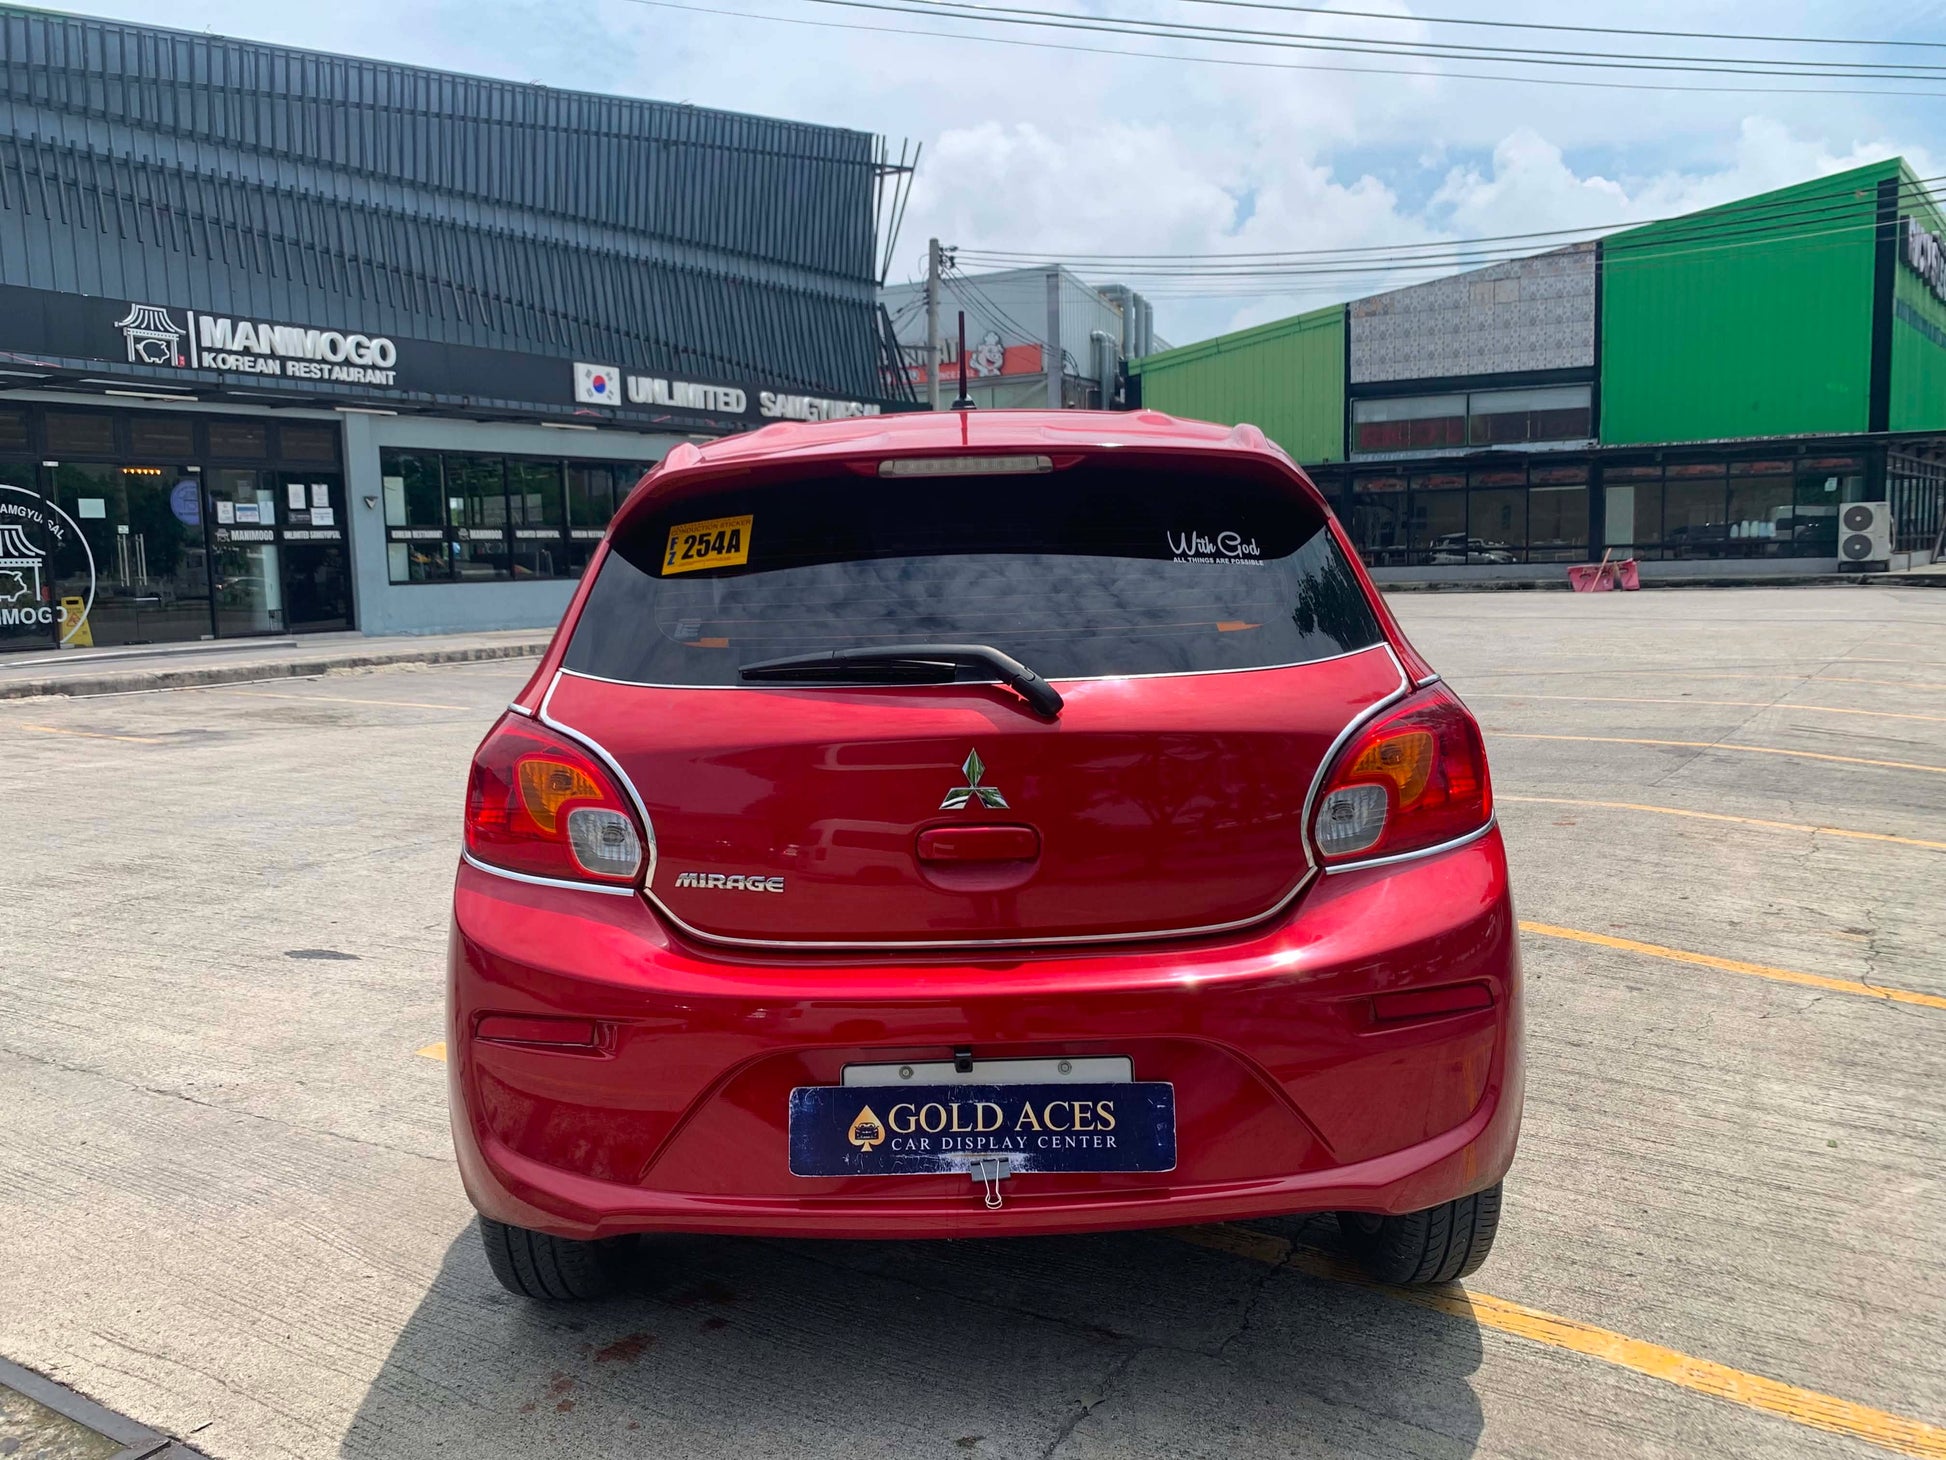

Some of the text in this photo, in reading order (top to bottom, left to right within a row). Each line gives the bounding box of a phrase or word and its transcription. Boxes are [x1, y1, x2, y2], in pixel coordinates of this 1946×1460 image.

[199, 315, 397, 368] MANIMOGO
[202, 352, 281, 375] KOREAN
[286, 361, 396, 386] RESTAURANT
[627, 375, 747, 414] UNLIMITED
[681, 529, 741, 560] 254A
[1167, 530, 1260, 557] With God
[1231, 558, 1264, 566] POSSIBLE
[675, 872, 784, 893] MIRAGE
[888, 1100, 1116, 1133] GOLD ACES
[891, 1135, 1117, 1151] CAR DISPLAY CENTER
